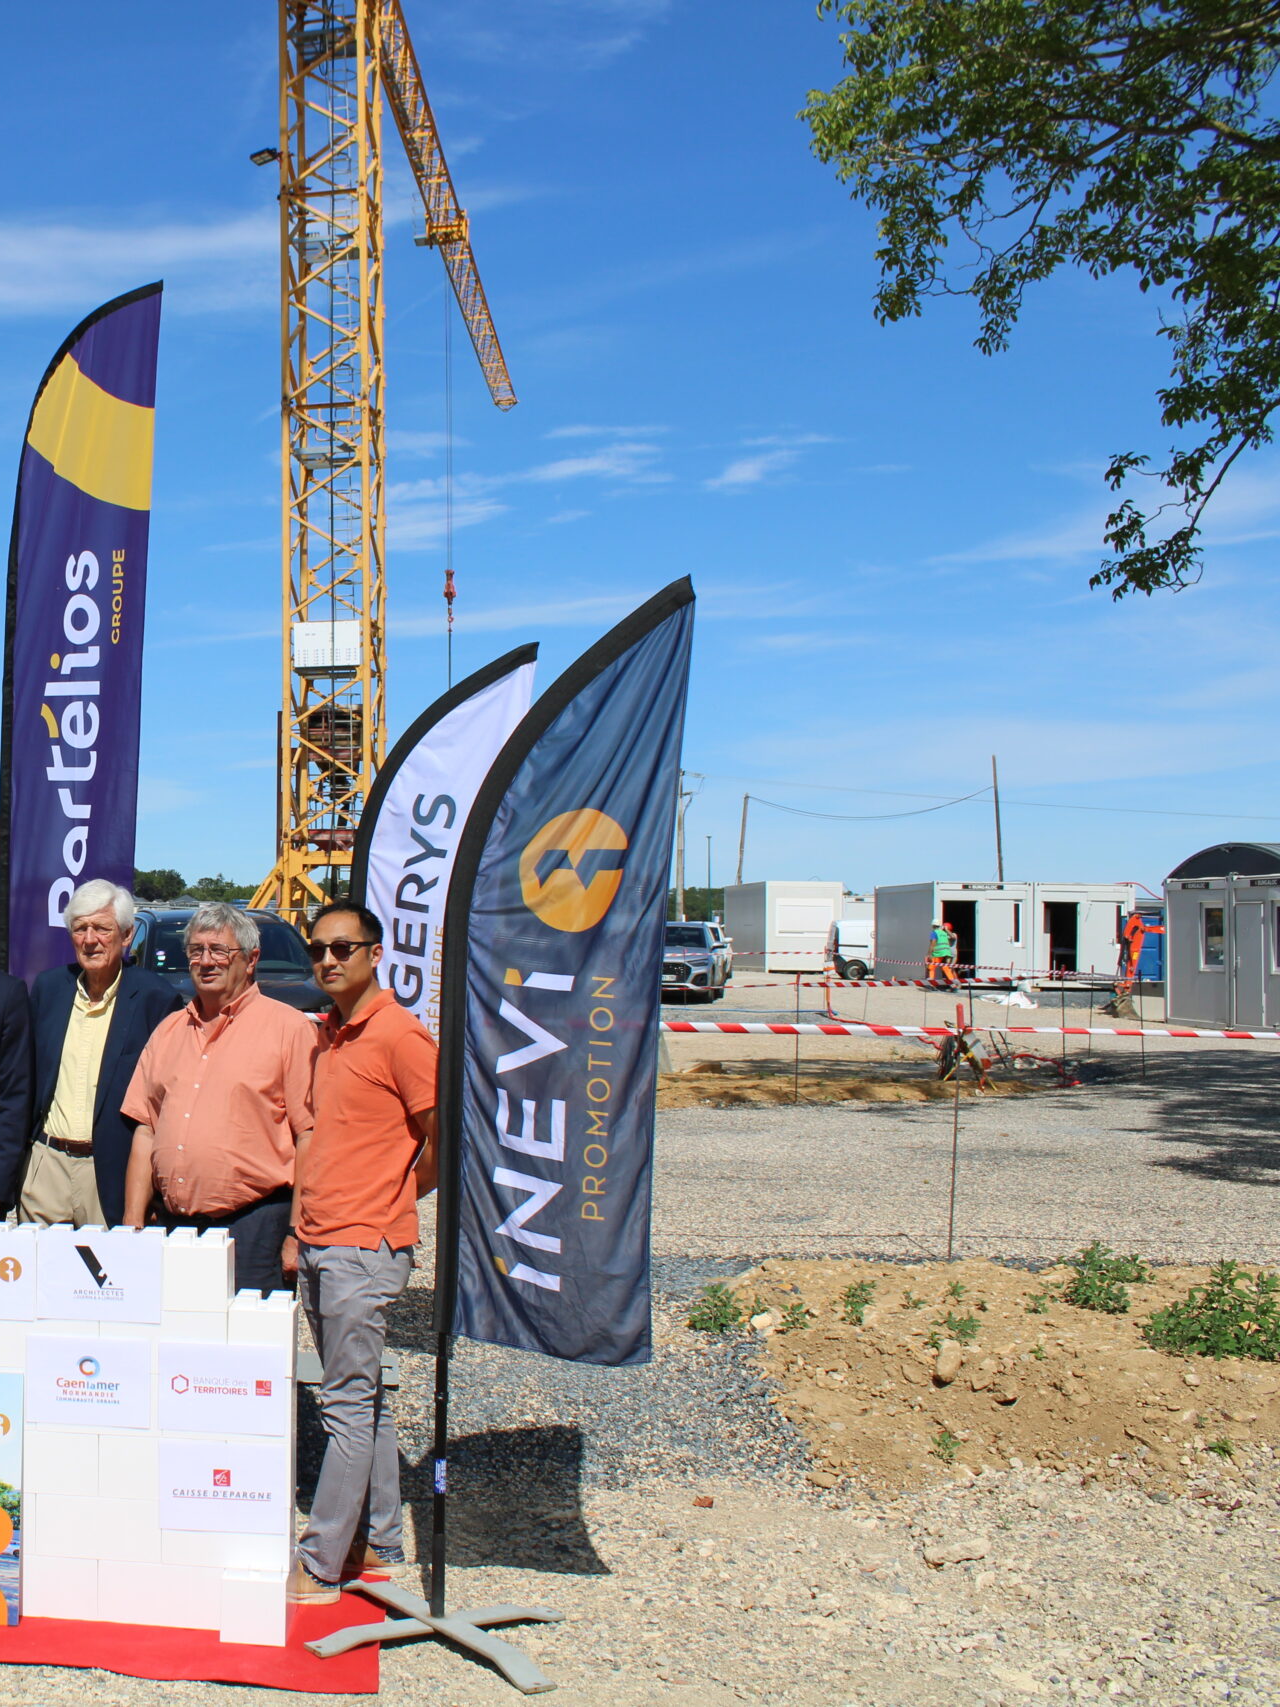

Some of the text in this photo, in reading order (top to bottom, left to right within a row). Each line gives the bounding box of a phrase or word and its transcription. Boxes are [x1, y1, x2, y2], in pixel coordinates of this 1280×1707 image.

[111, 548, 126, 644] GROUPE
[40, 549, 100, 928] Partélios
[388, 793, 457, 1019] GERYS
[425, 925, 445, 1044] GÉNIERIE
[580, 976, 616, 1221] PROMOTION
[73, 1289, 125, 1297] ARCHITECTES
[62, 1389, 114, 1398] NORMANDIE
[193, 1376, 230, 1386] BANQUE
[193, 1386, 248, 1396] TERRITOIRES
[172, 1488, 272, 1500] CAISSE D'EPARGNE
